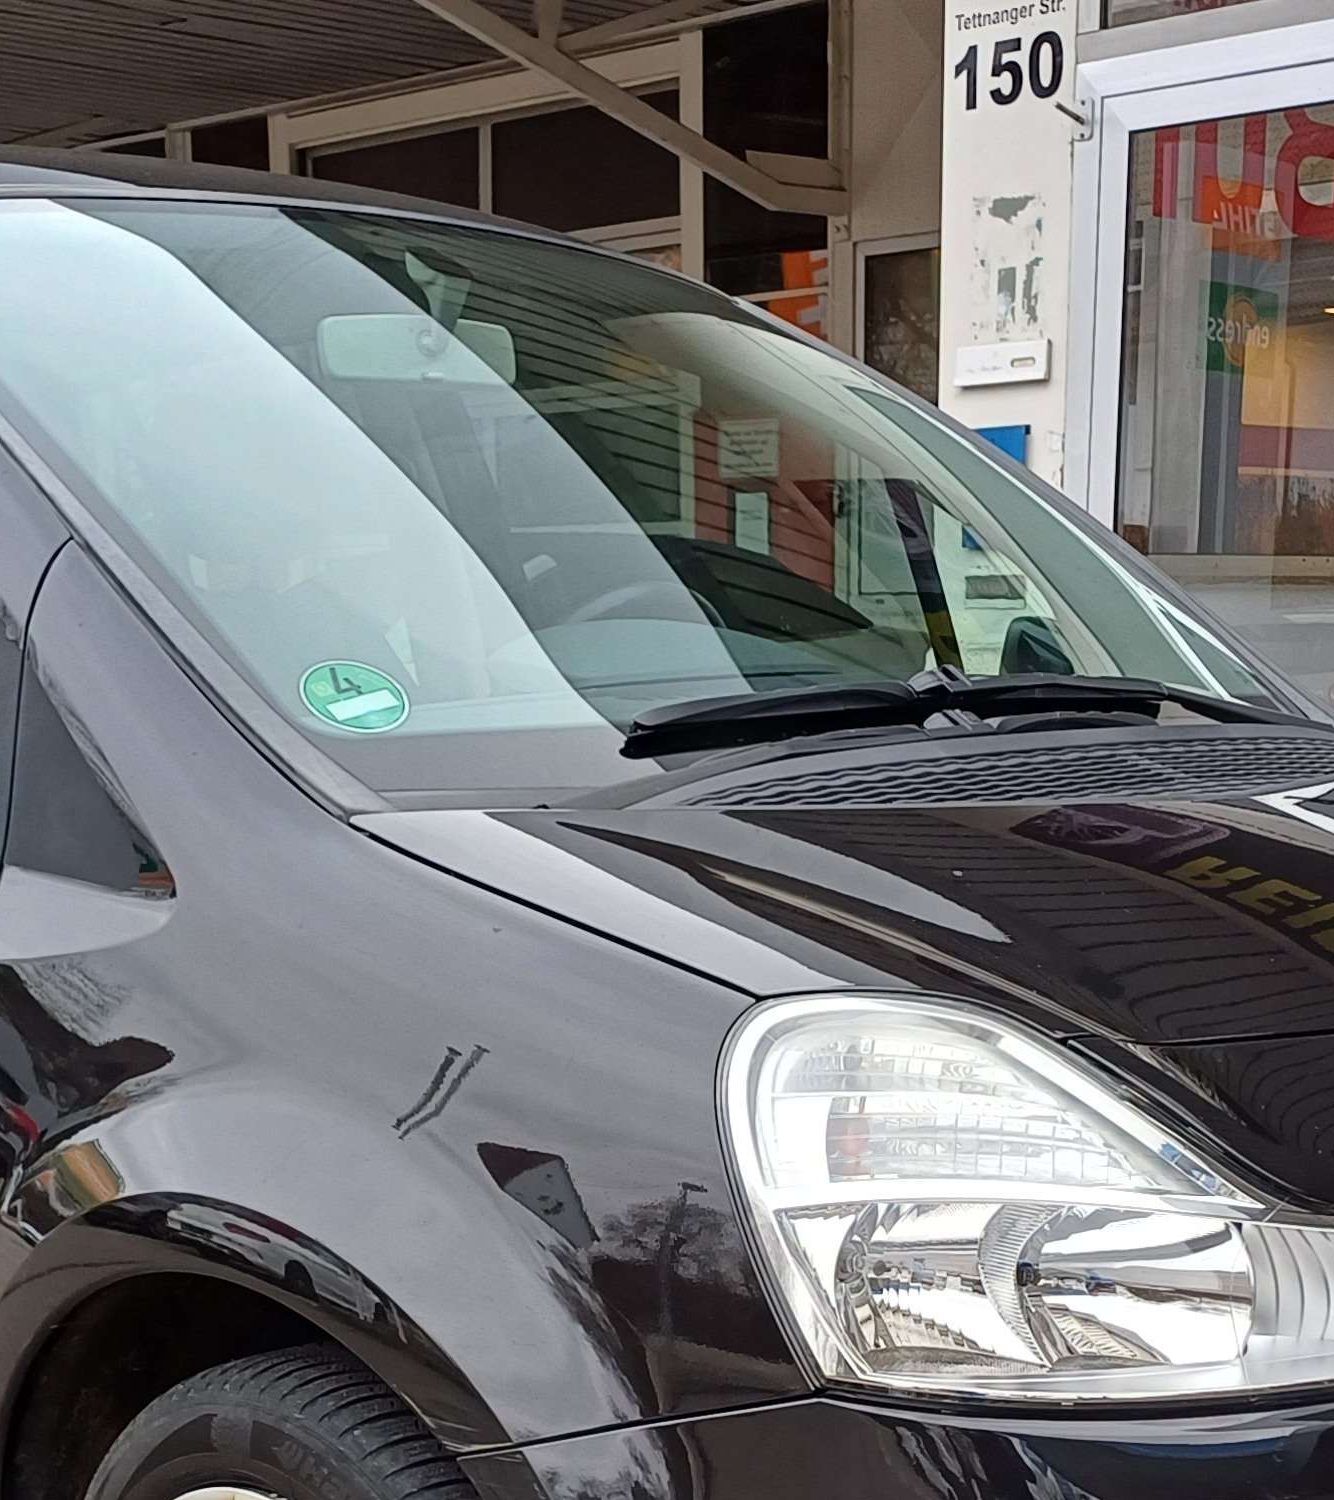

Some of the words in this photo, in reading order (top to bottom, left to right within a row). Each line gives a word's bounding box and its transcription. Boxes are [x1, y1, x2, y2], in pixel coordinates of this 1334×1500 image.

[955, 3, 1035, 31] Tettnanger
[1040, 0, 1066, 14] Str.
[954, 31, 1064, 111] 150
[329, 667, 363, 694] 4
